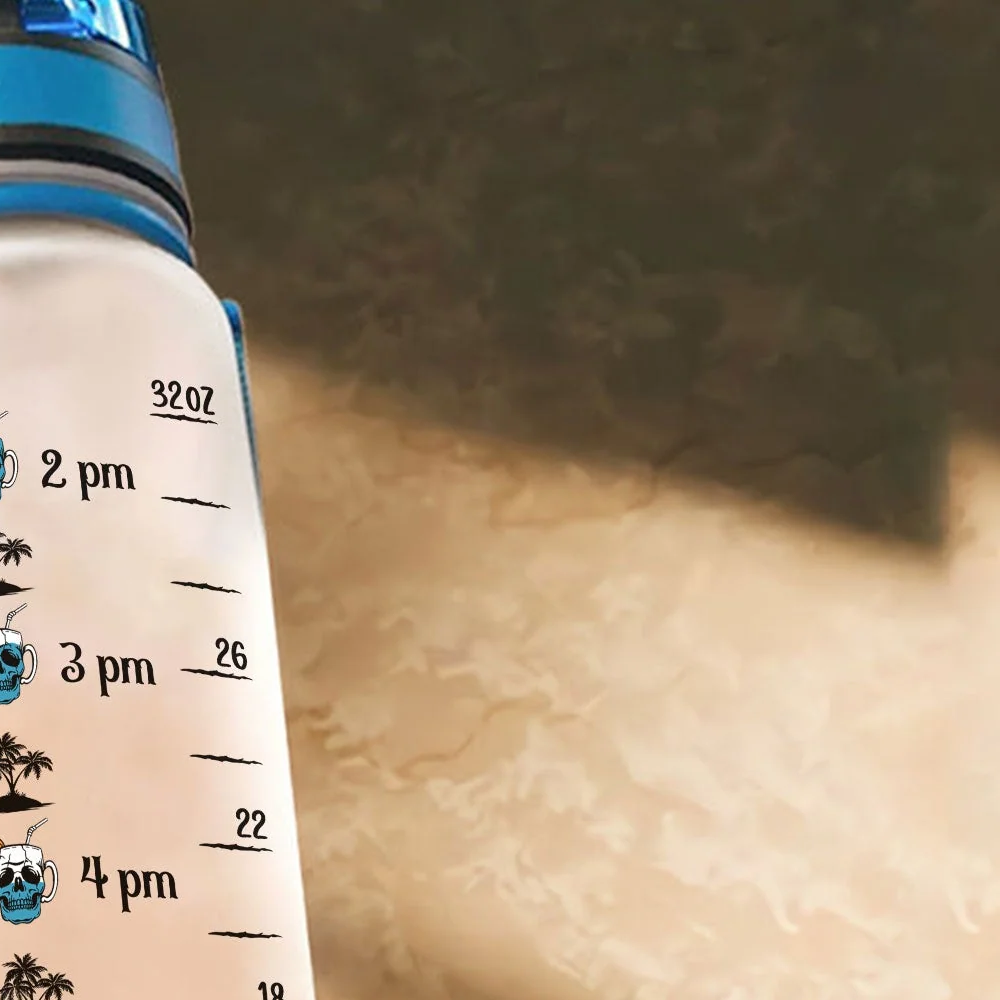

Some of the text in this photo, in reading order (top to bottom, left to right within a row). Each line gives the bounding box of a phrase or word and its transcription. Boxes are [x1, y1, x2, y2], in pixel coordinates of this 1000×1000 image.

[41, 448, 136, 502] 2 pm
[59, 641, 157, 698] 3 pm
[215, 637, 248, 671] 26
[235, 807, 268, 840] 22
[80, 855, 179, 914] 4 pm
